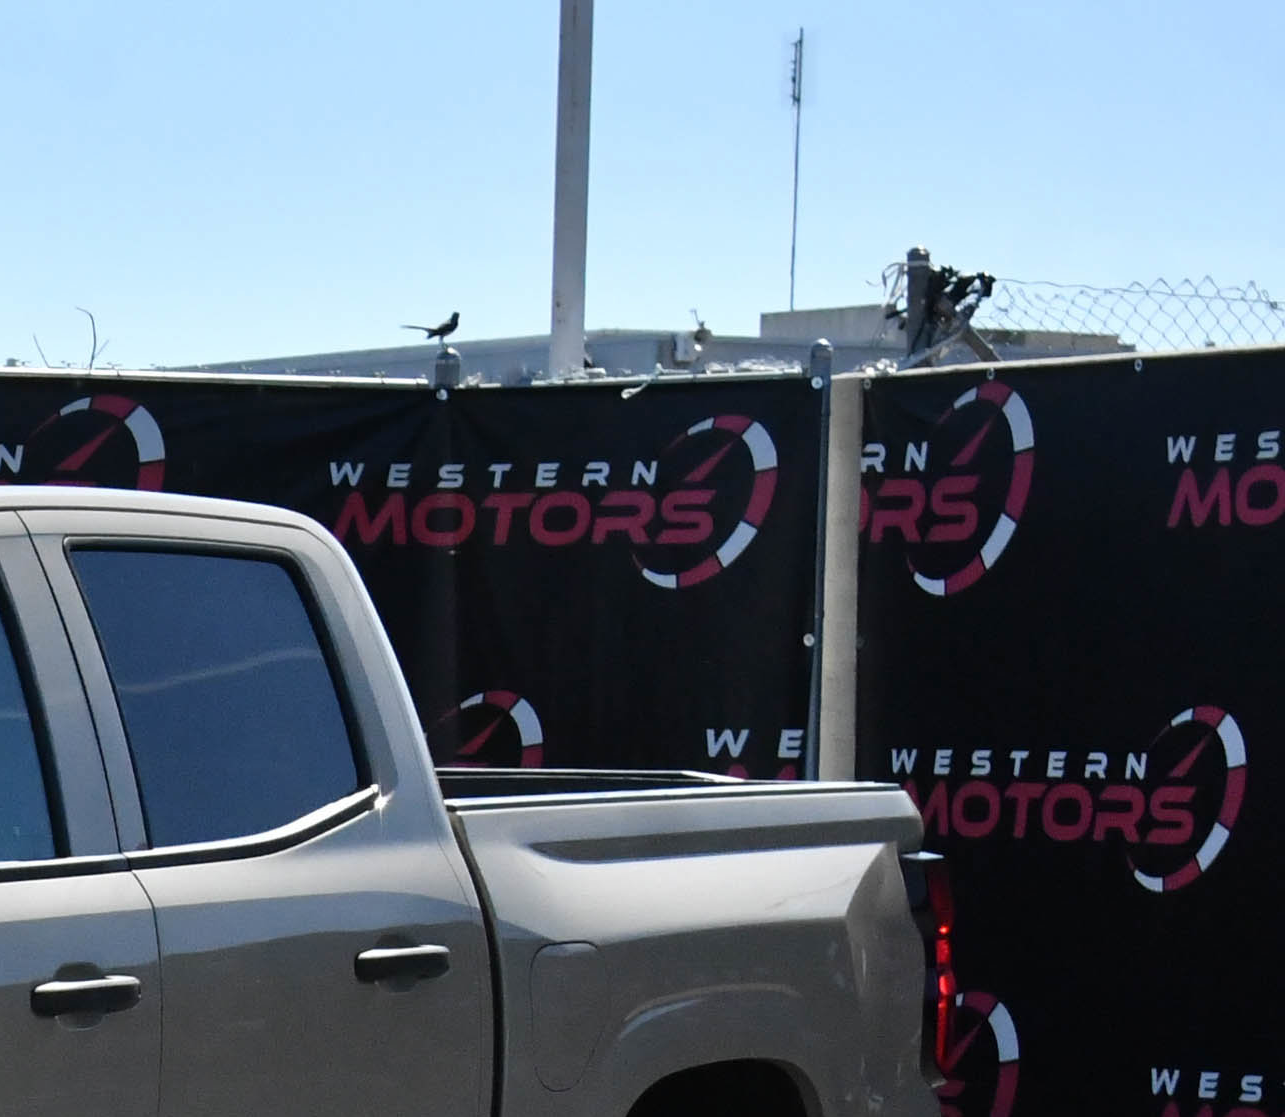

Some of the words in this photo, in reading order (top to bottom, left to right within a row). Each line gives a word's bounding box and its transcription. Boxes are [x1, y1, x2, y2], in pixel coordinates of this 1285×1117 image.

[330, 460, 658, 488] WESTERN
[332, 490, 716, 547] MOTORS
[892, 748, 1148, 780] WESTERN
[1150, 1067, 1285, 1102] WES
